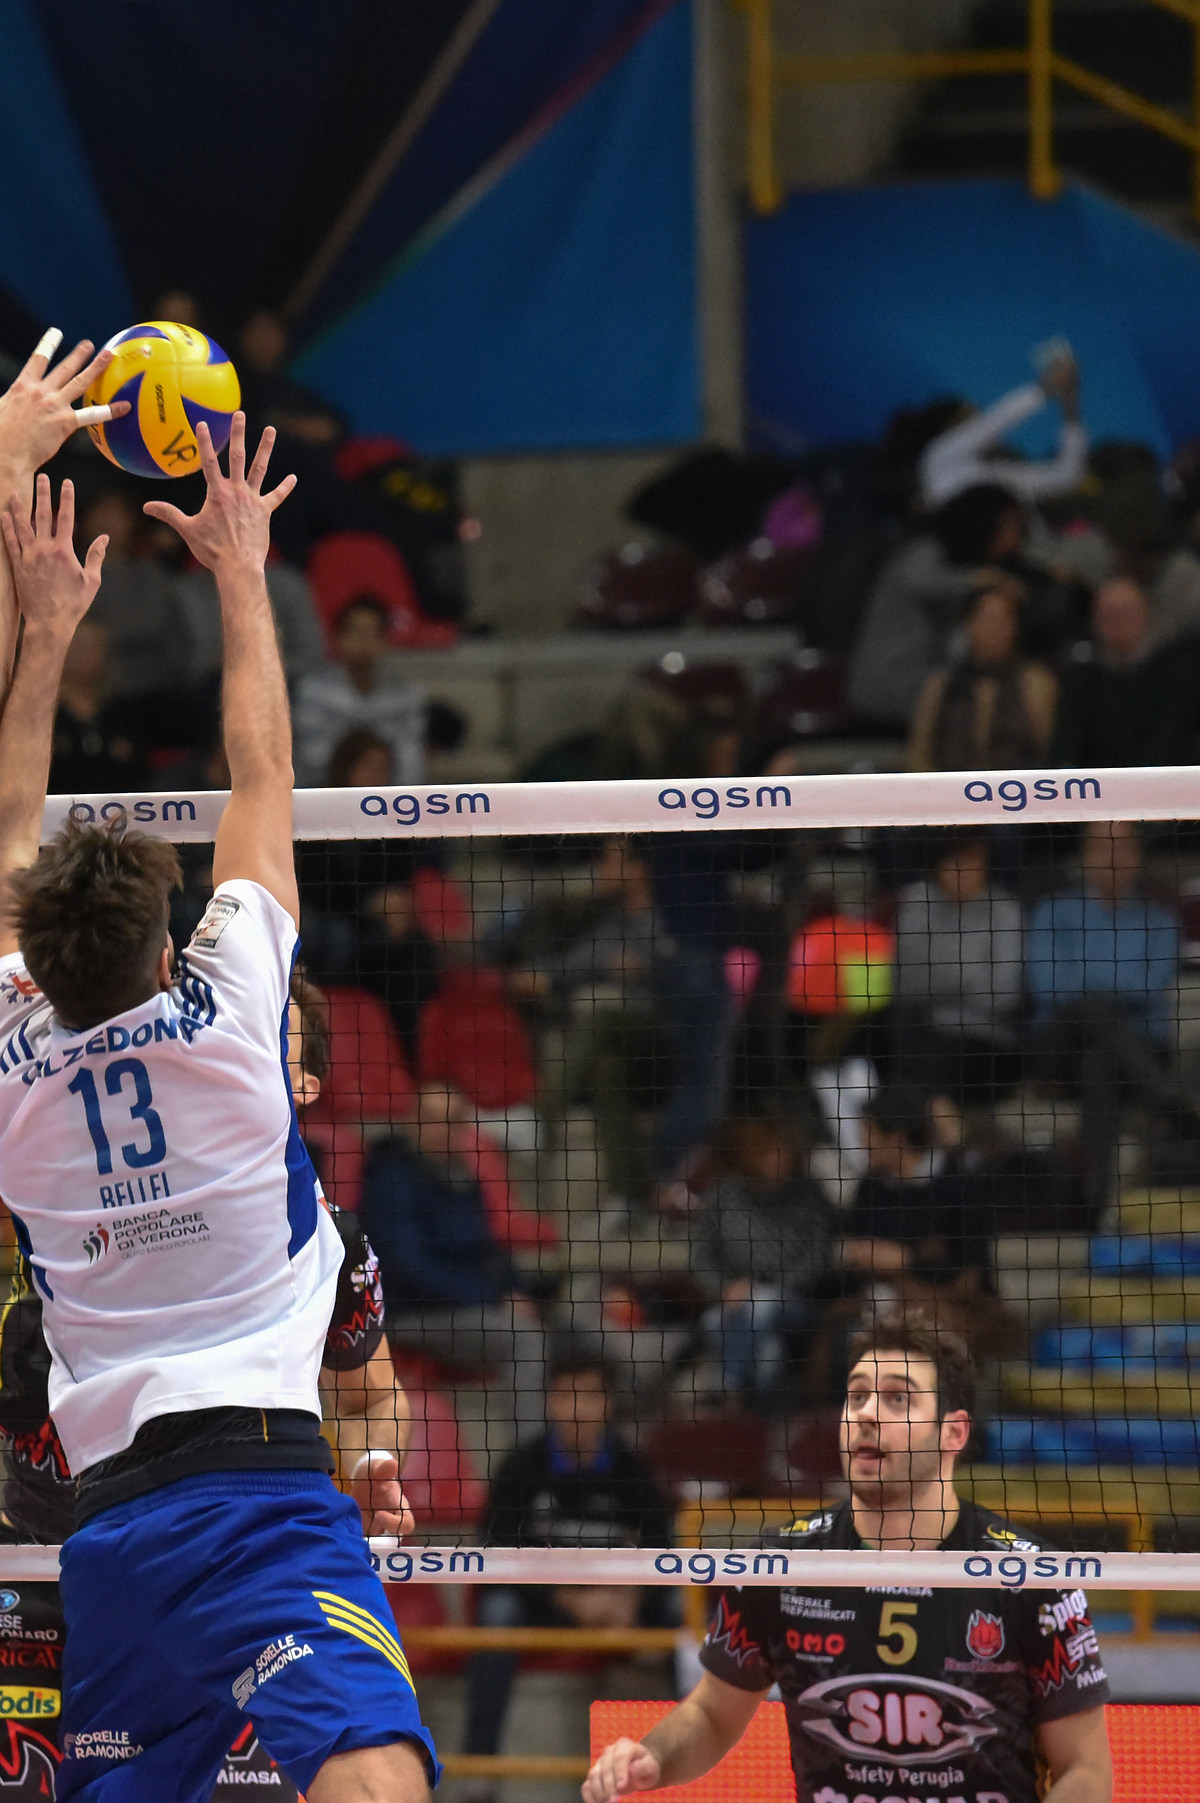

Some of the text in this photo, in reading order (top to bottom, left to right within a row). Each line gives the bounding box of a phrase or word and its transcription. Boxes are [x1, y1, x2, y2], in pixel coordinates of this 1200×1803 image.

[360, 792, 491, 826] agsm
[658, 785, 792, 819] agsm
[964, 777, 1102, 811] agsm
[68, 800, 196, 832] agsm
[67, 1057, 166, 1175] 13
[113, 1209, 171, 1230] BANCA
[114, 1211, 204, 1241] POPOLARE
[117, 1223, 209, 1251] DI VERONA
[654, 1553, 789, 1584] agsm
[964, 1556, 1101, 1587] agsm
[877, 1601, 918, 1666] 5
[255, 1634, 295, 1672] SORELLE
[257, 1644, 313, 1685] RAMONDA
[847, 1689, 944, 1746] SIR
[75, 1730, 131, 1746] SORELLE
[75, 1744, 144, 1760] RAMONDA
[844, 1763, 965, 1789] Safety Perugia
